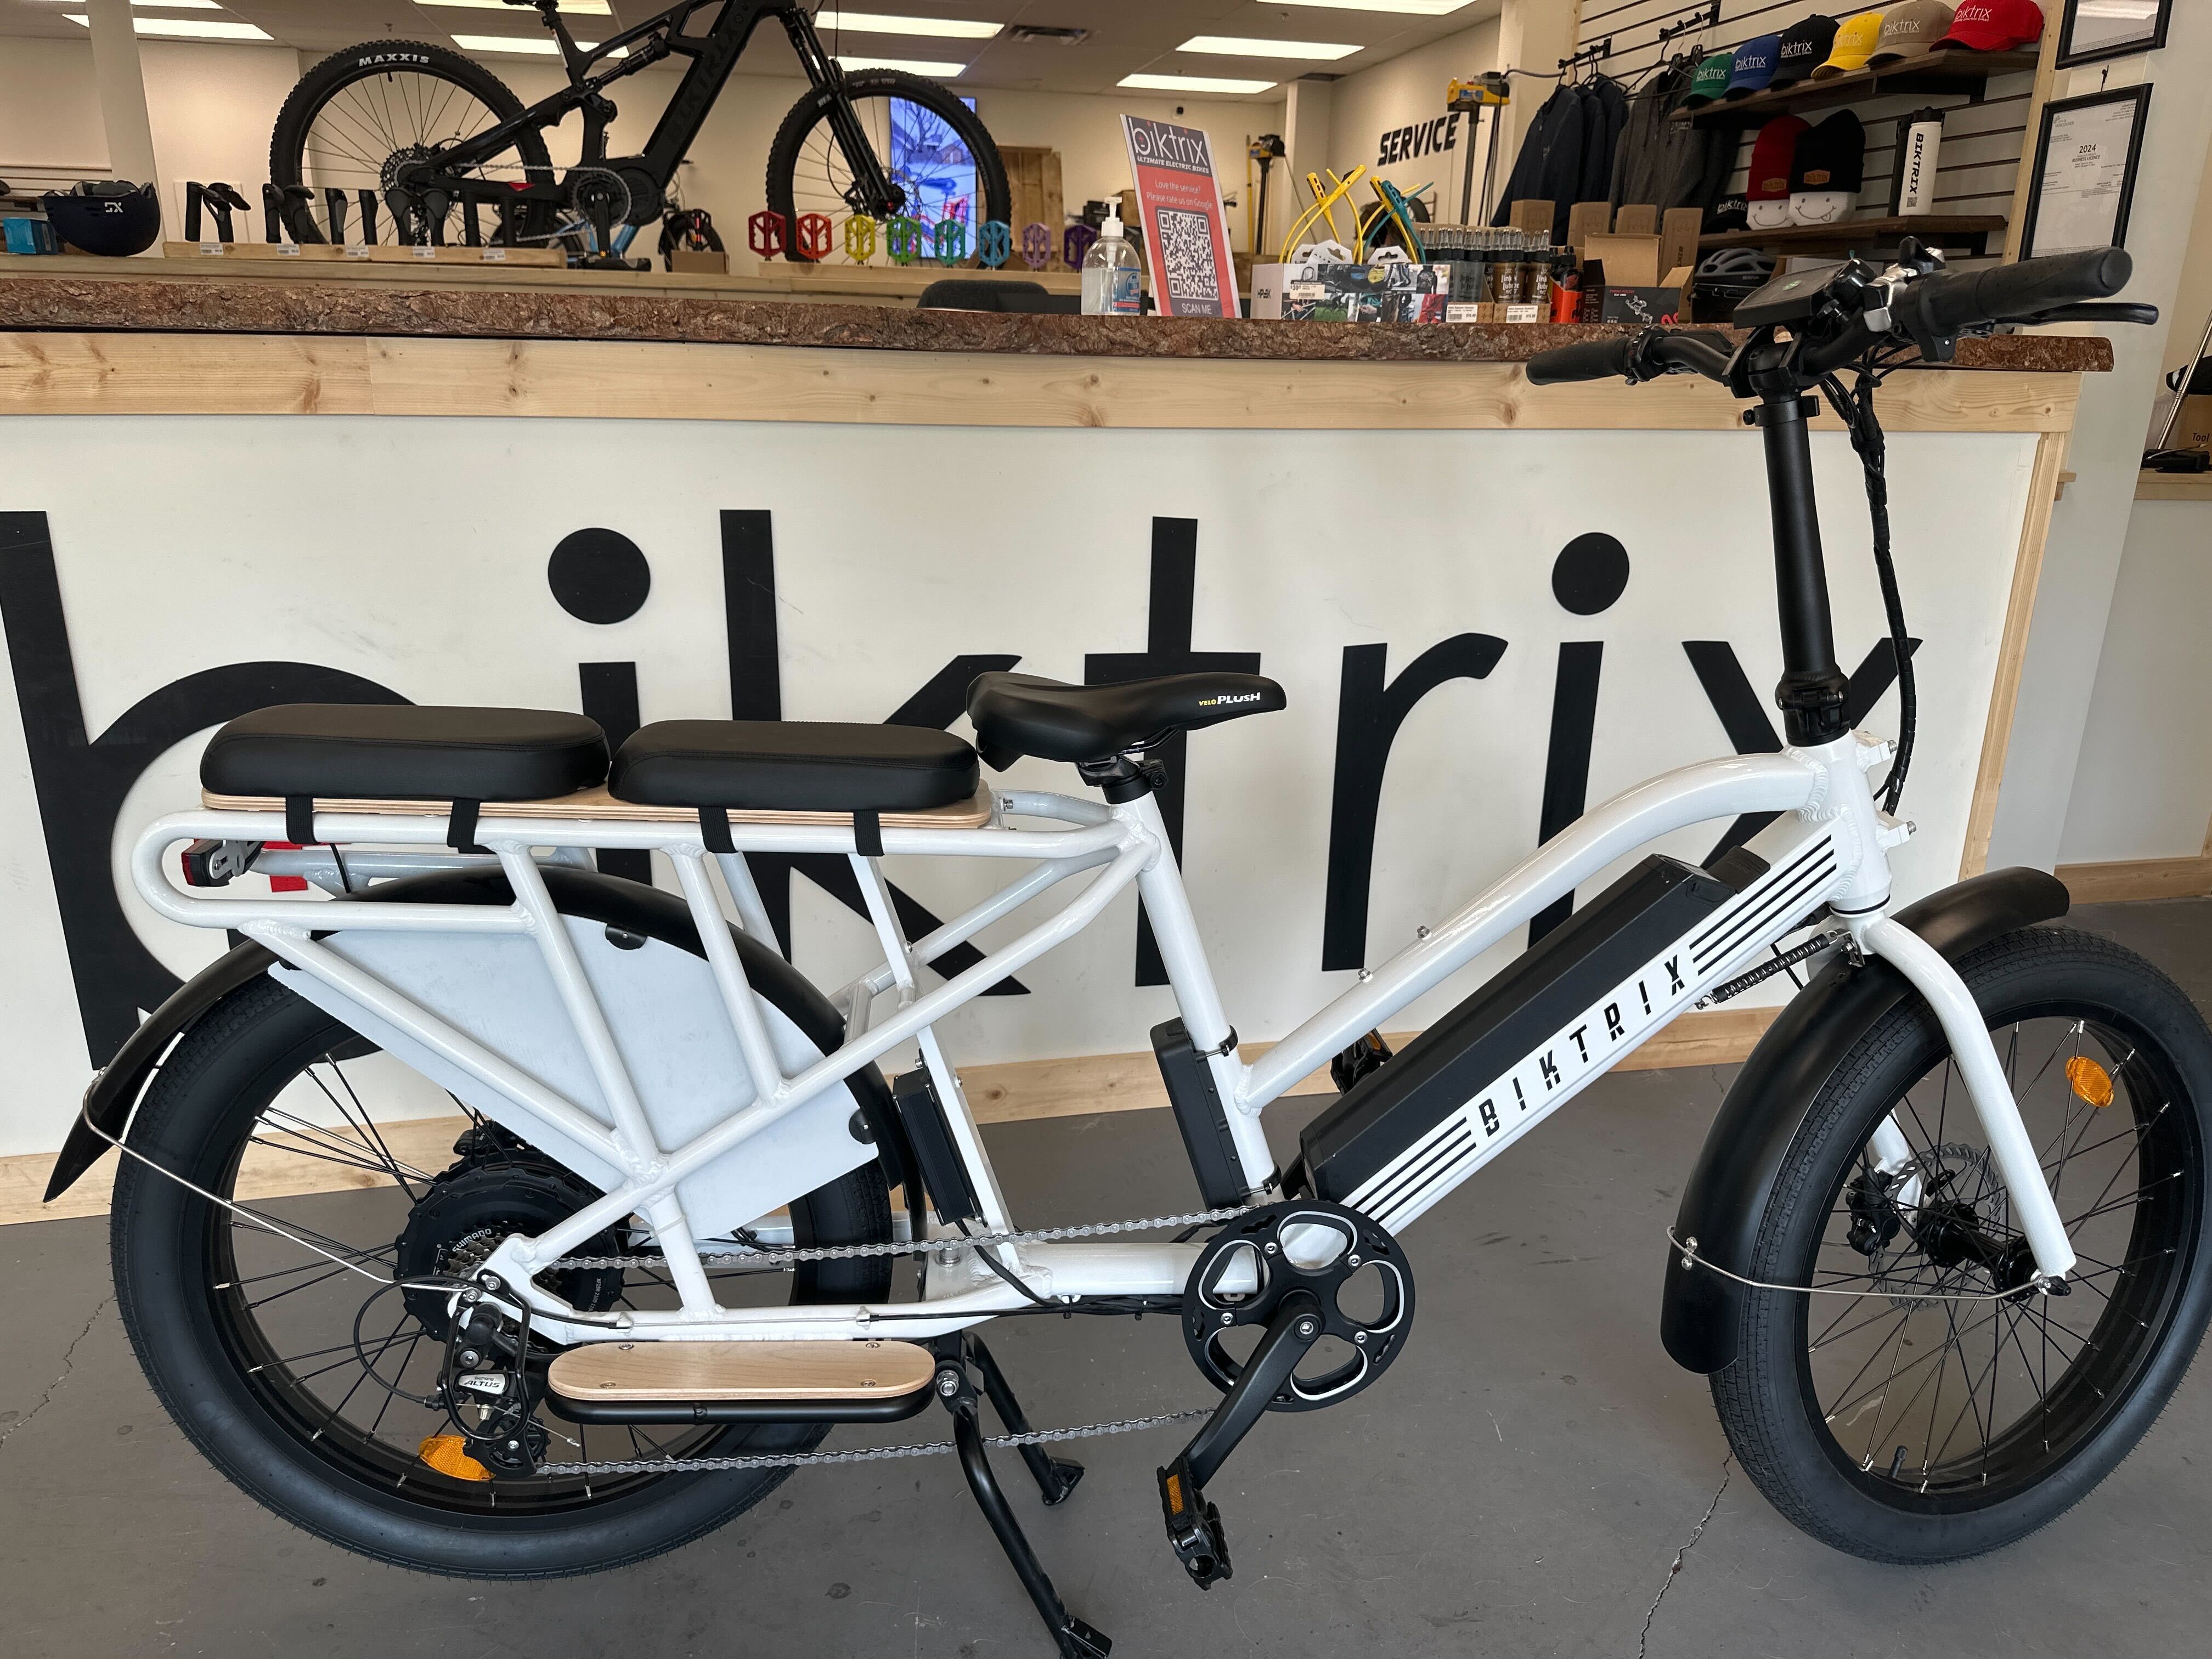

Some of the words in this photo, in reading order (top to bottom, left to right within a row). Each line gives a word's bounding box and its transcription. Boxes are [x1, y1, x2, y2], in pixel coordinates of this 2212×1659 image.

[1955, 4, 1993, 20] biktrix
[1781, 40, 1813, 55] biktrix
[359, 53, 430, 66] MAXXIS
[1735, 54, 1767, 69] biktrix
[1697, 67, 1726, 80] biktrix
[1128, 117, 1208, 166] biktrix
[1377, 112, 1460, 167] SERVICE
[2079, 143, 2096, 154] 2024
[1137, 155, 1165, 166] ULTIMATE
[1166, 160, 1192, 171] ELECTRIC
[1192, 165, 1209, 174] BIKES
[1909, 132, 1924, 195] BIKTRIX
[1155, 178, 1169, 190] Love
[1169, 180, 1180, 191] the
[1146, 191, 1166, 202] Please
[1194, 198, 1213, 211] Google
[1181, 303, 1201, 314] SCAN
[1201, 304, 1212, 315] ME
[2193, 432, 2210, 442] Tool
[1217, 692, 1261, 704] PLUSH
[1478, 955, 1685, 1137] BIKTRIX
[464, 1380, 501, 1388] ALTUS
